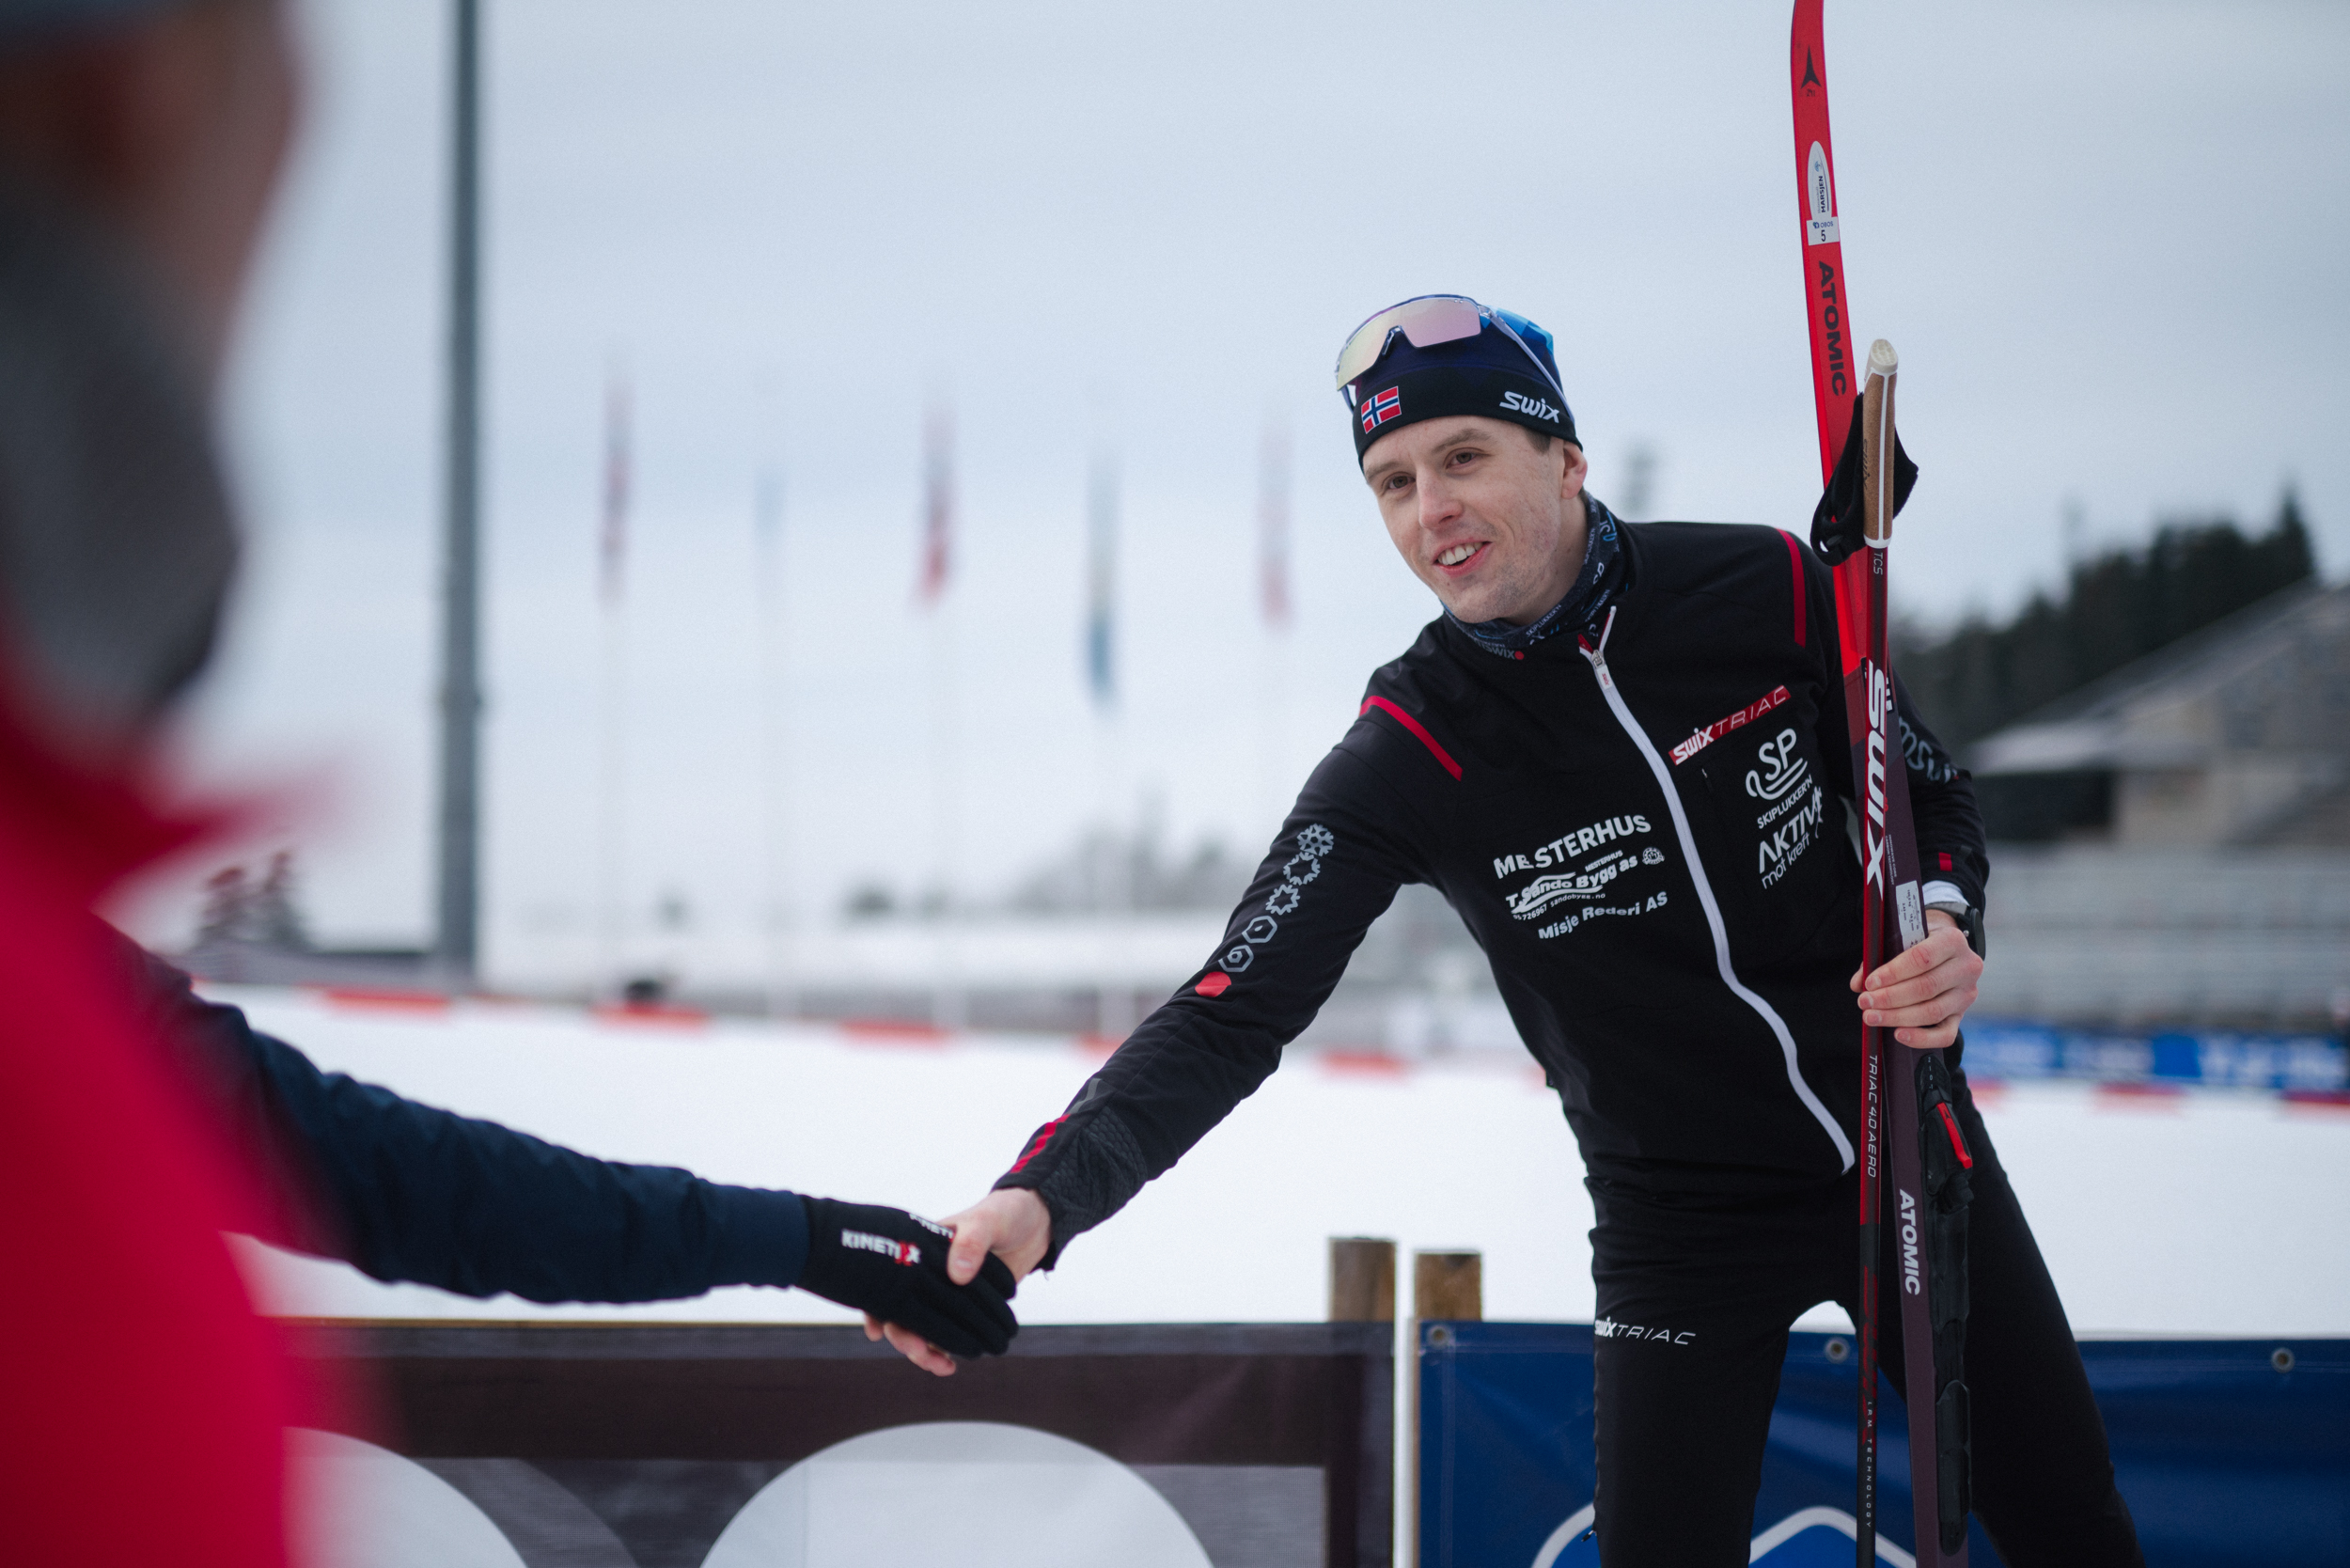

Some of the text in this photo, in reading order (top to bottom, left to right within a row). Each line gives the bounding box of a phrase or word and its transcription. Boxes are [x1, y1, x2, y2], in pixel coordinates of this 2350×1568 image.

[1821, 229, 1826, 242] 5
[1819, 260, 1847, 397] ATOMIC
[1493, 814, 1652, 880] MESTERHUS
[1585, 850, 1623, 873] MESTERHUS
[1762, 832, 1810, 889] mot kreft
[1576, 863, 1618, 888] Bygg
[1619, 855, 1638, 872] as
[1538, 891, 1668, 939] Misje Rederi AS
[1869, 1055, 1878, 1105] TRIAC
[1868, 1131, 1877, 1178] AERO
[1899, 1188, 1920, 1296] ATOMIC
[1617, 1324, 1697, 1345] TRIAC
